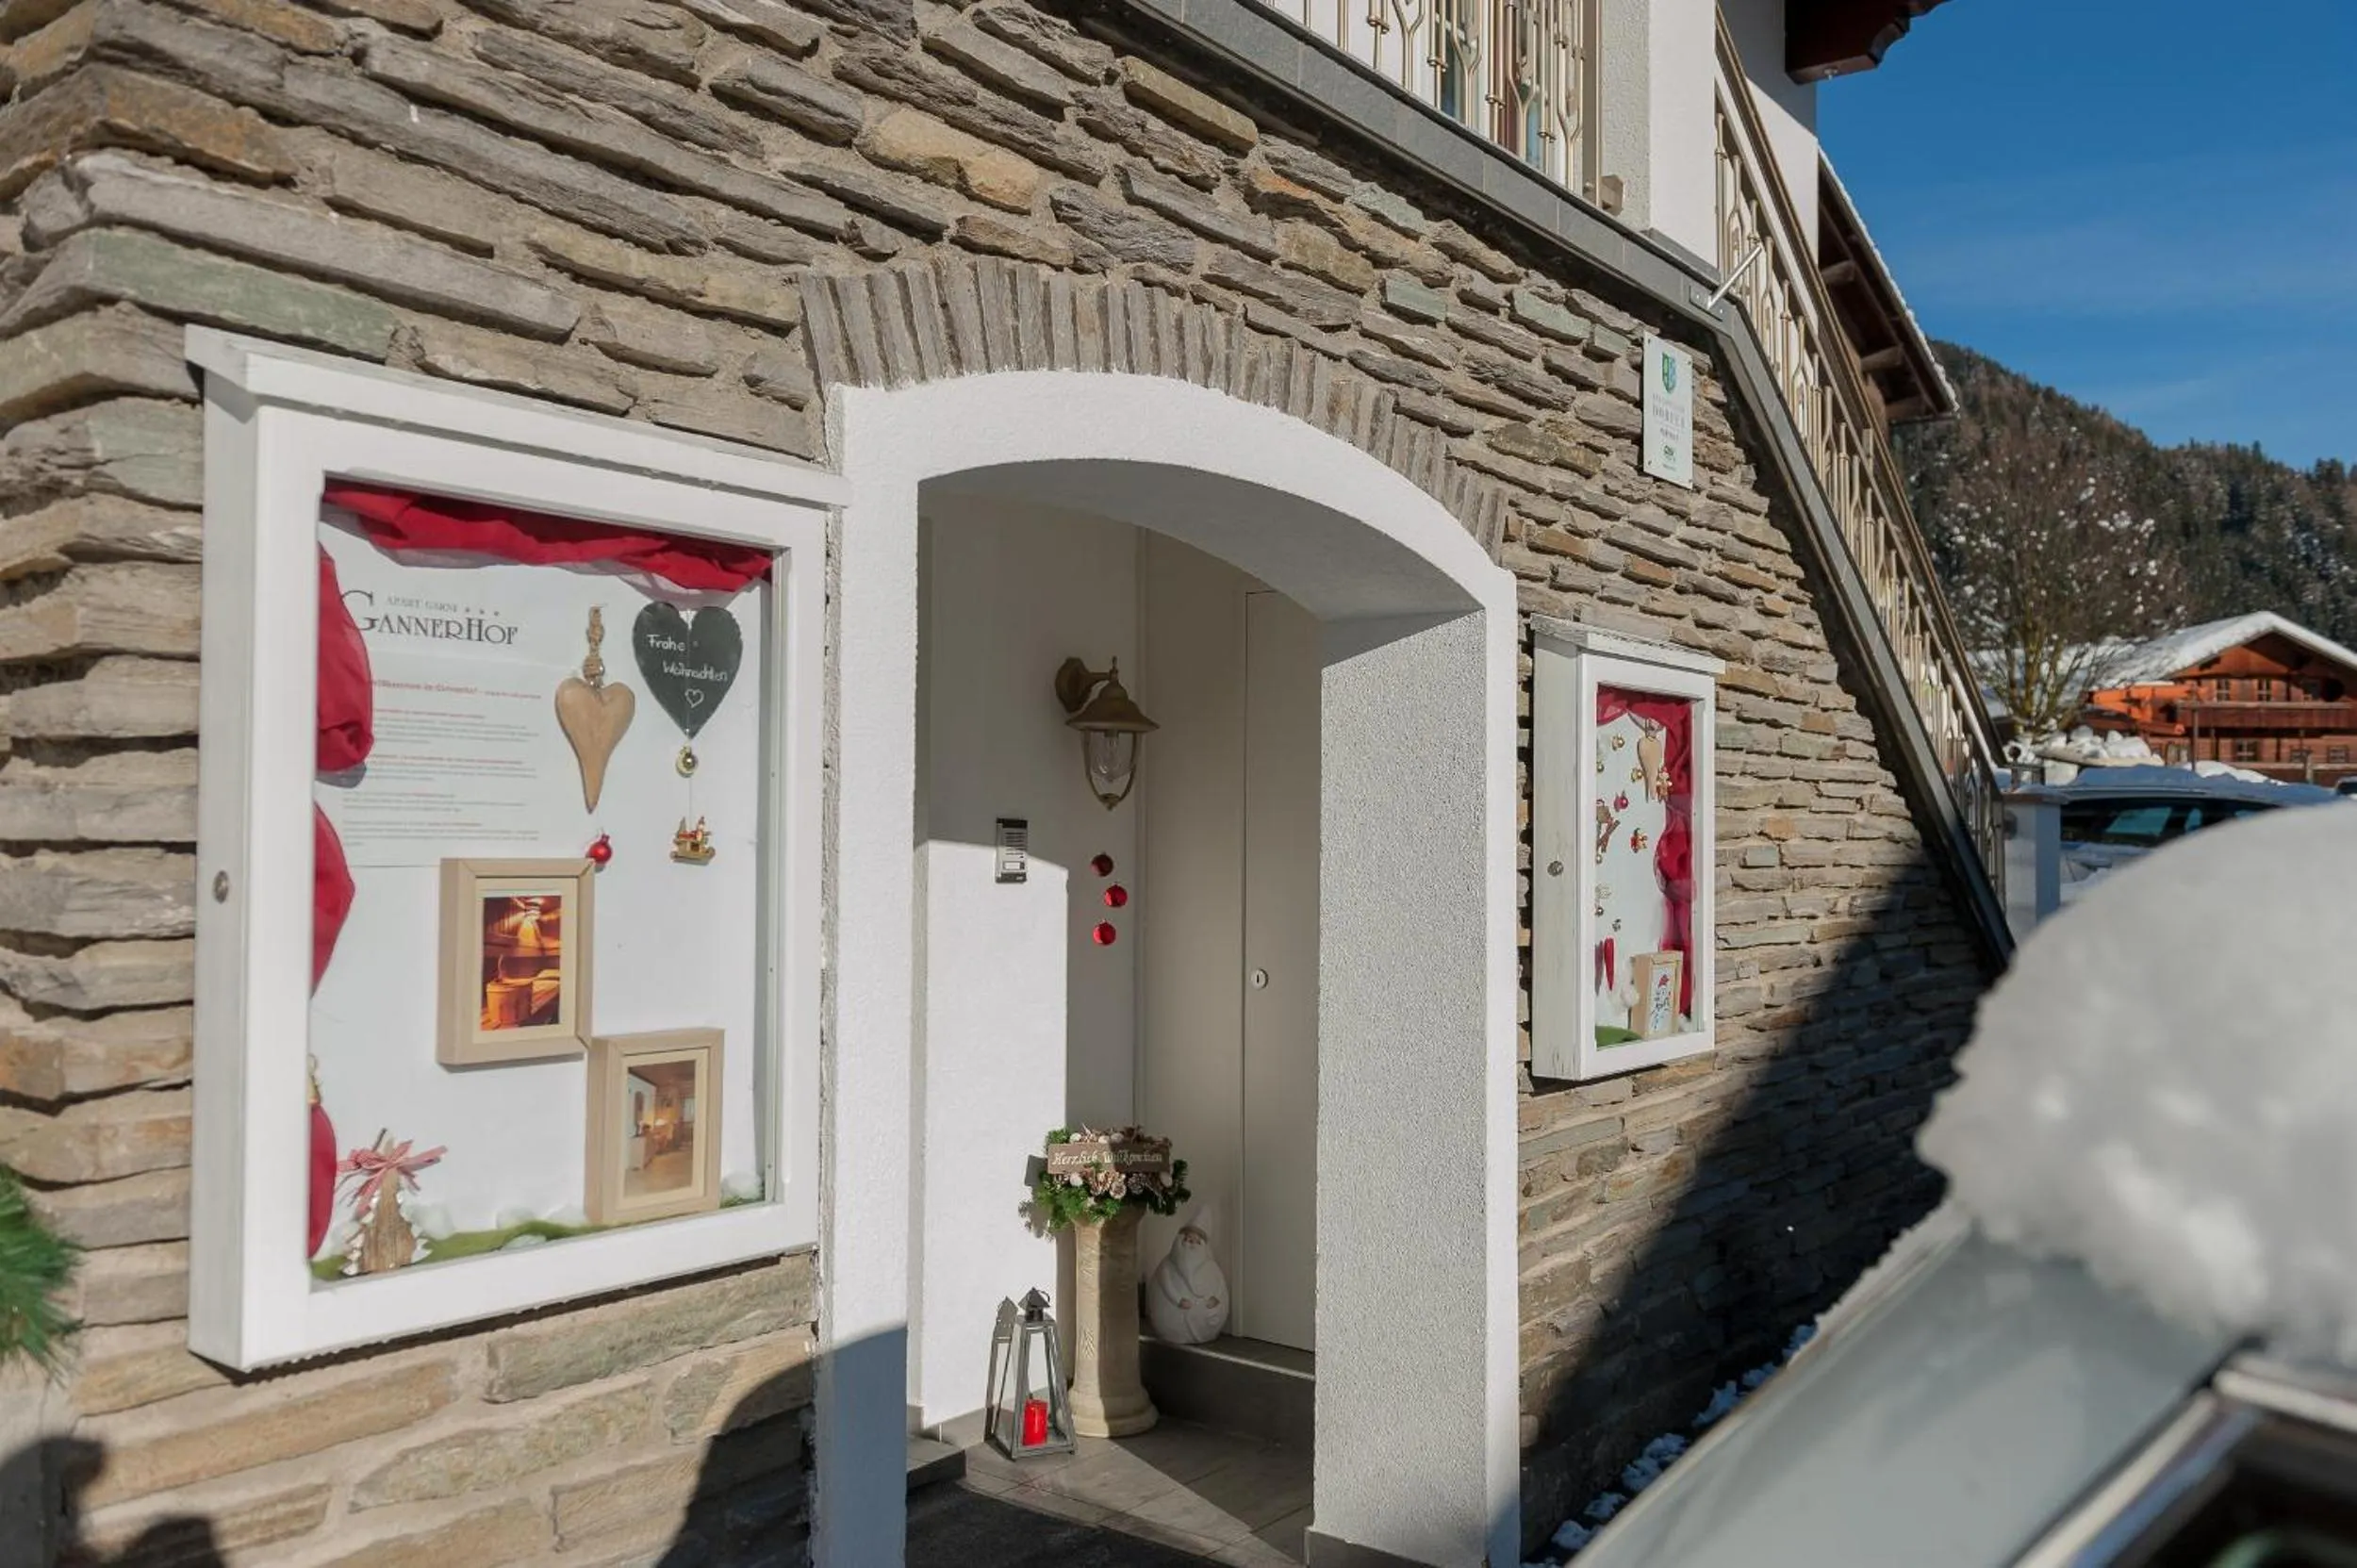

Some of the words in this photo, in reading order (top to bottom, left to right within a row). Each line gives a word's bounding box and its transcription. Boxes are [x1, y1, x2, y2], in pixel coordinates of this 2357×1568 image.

[646, 634, 685, 652] Frohe
[663, 660, 728, 682] Weihnachten
[1051, 1150, 1098, 1166] Herzlich
